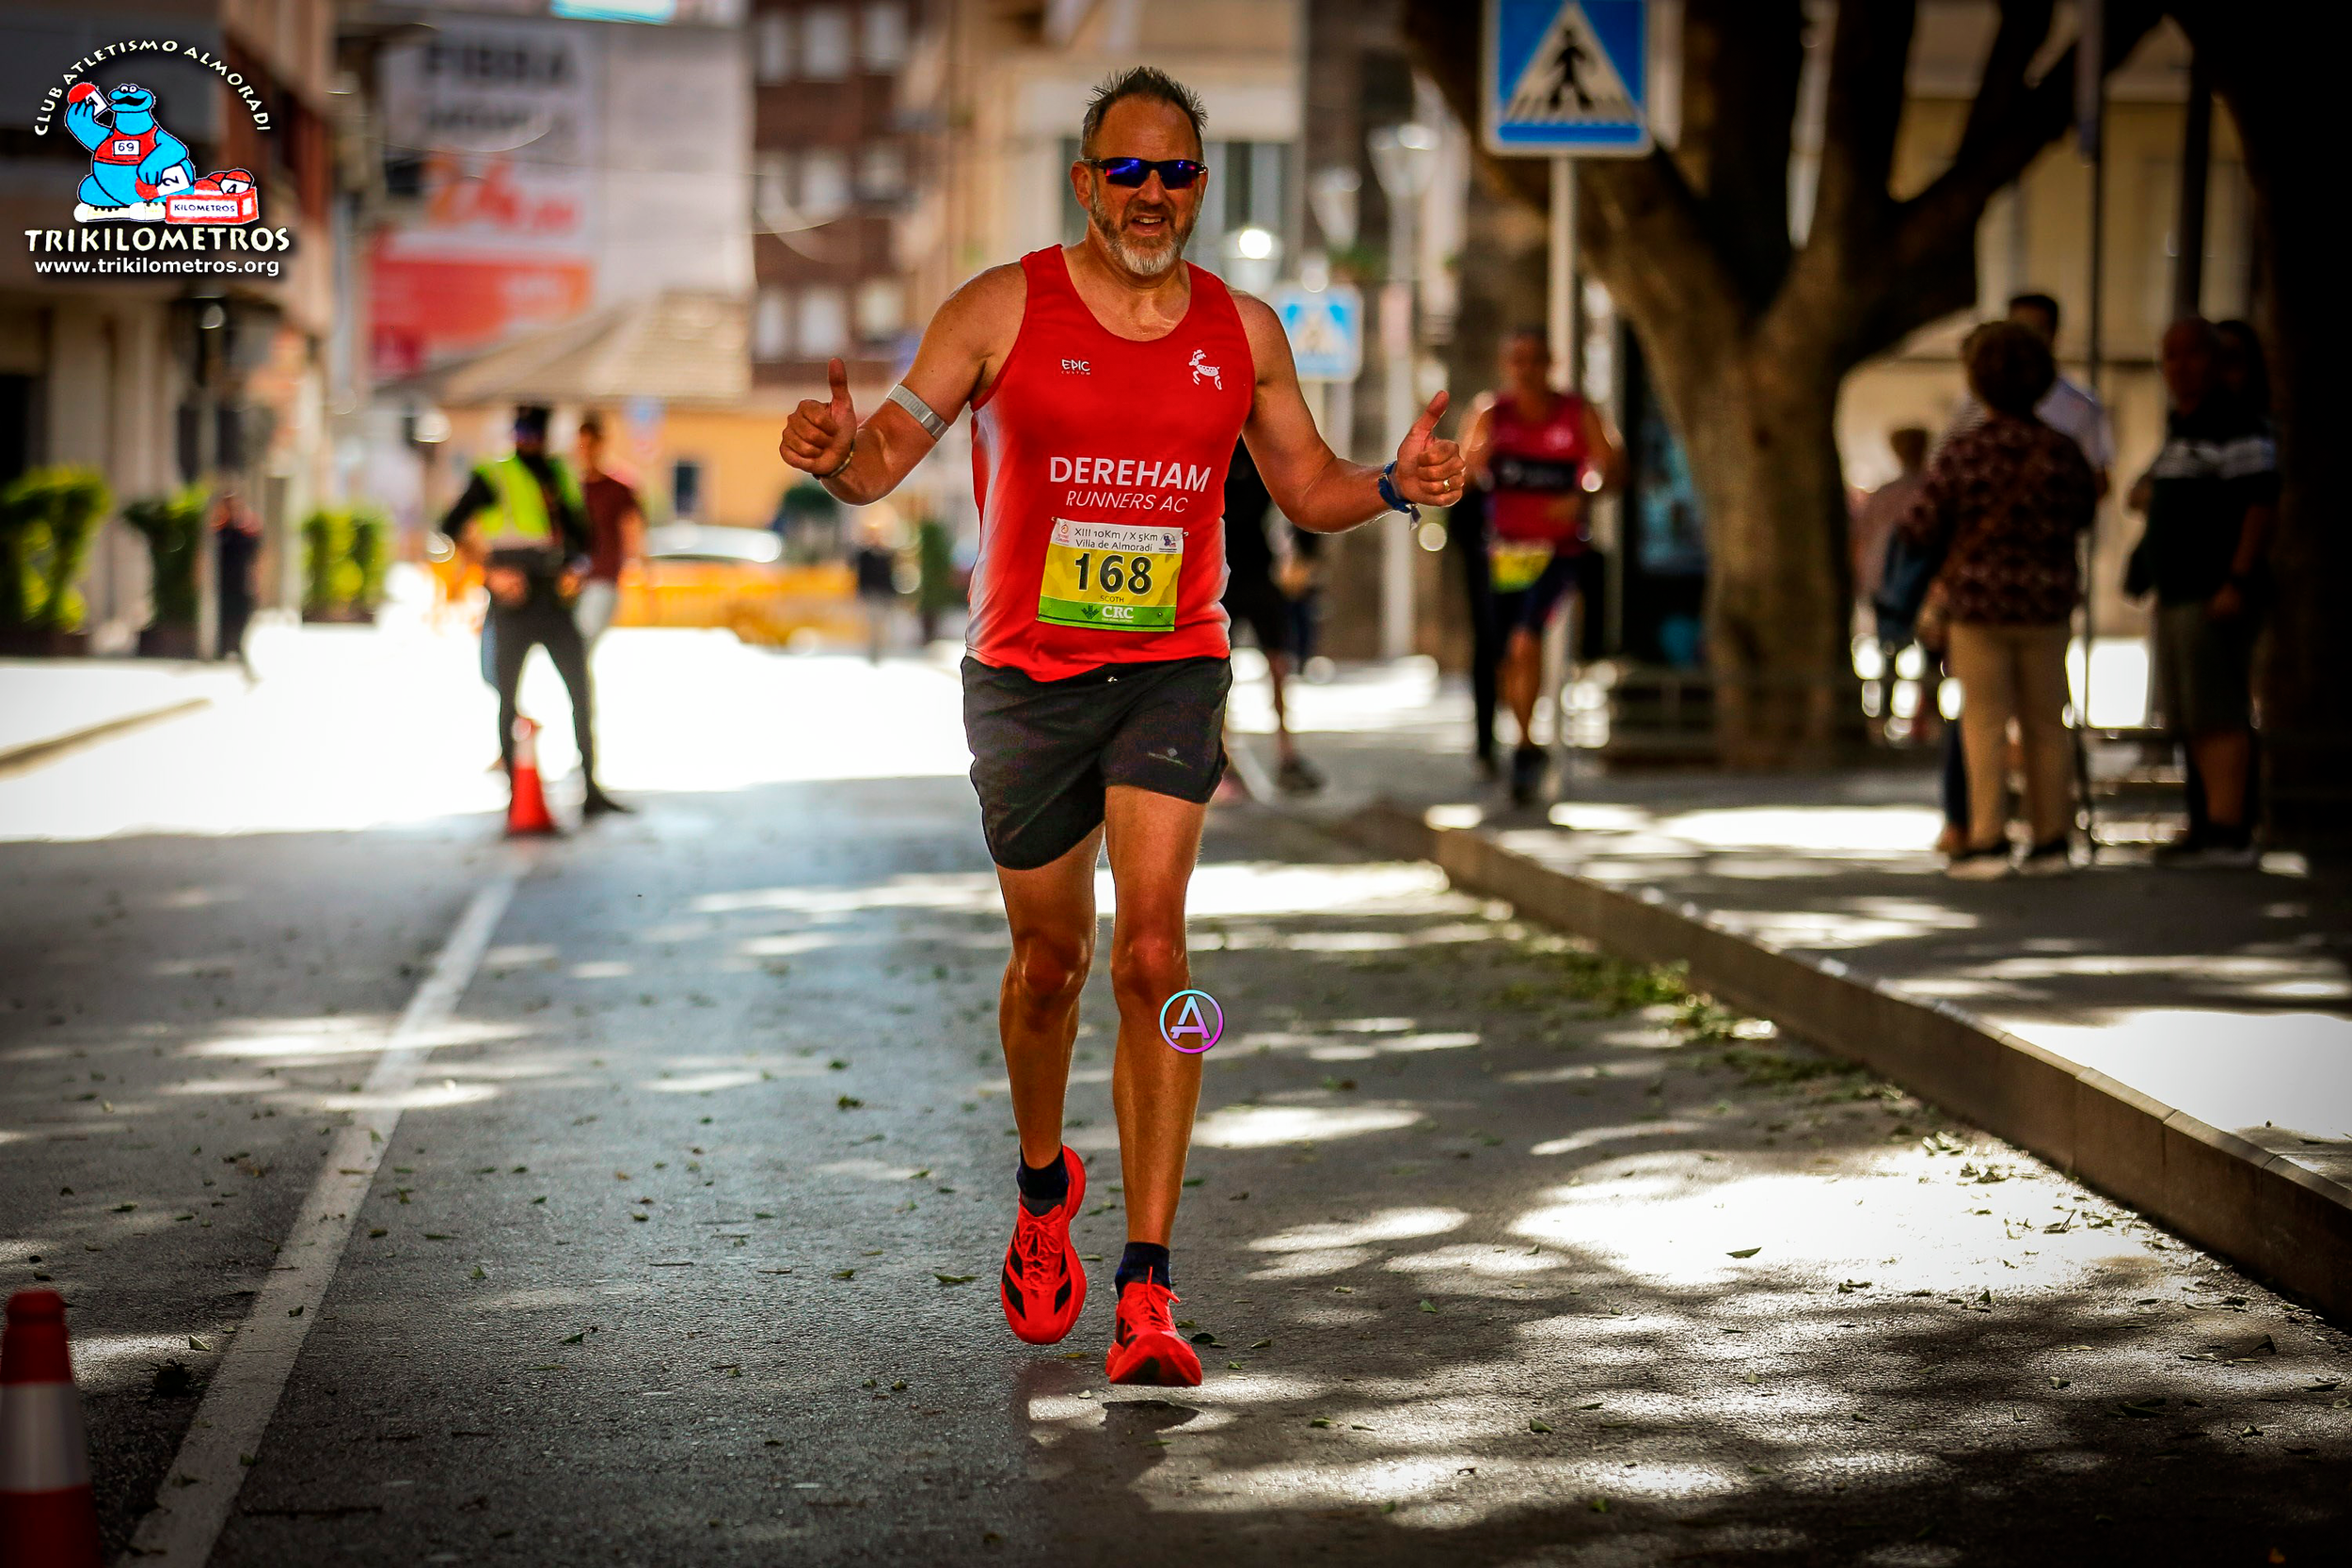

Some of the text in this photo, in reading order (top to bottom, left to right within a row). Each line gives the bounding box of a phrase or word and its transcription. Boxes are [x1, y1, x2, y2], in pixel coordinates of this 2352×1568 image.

[1061, 358, 1090, 372] EPIC
[1050, 456, 1212, 493] DEREHAM
[1066, 490, 1189, 513] RUNNERS AC
[1074, 528, 1091, 537] XIII
[1094, 530, 1120, 540] 10Km
[1138, 532, 1158, 542] 5Km
[1075, 539, 1096, 548] Villa
[1098, 540, 1109, 549] de
[1111, 541, 1153, 552] Almoradí
[1074, 552, 1152, 595] 168
[1100, 594, 1125, 603] SCOTH
[1102, 606, 1135, 619] CRC
